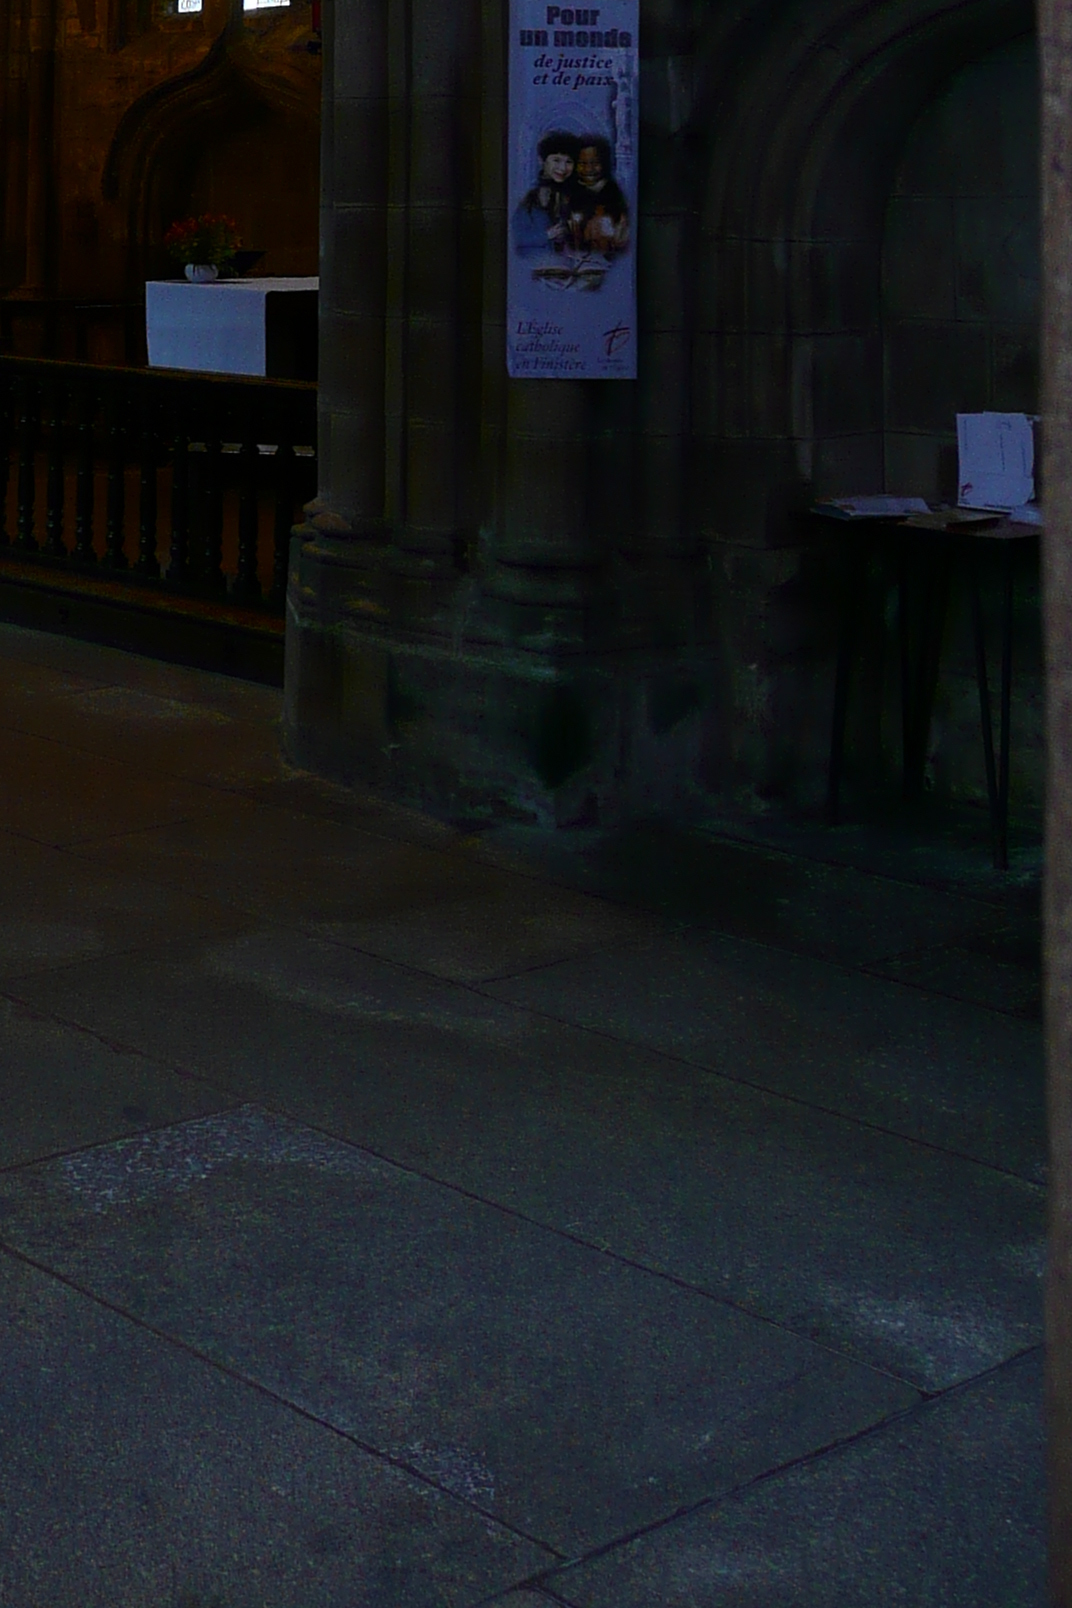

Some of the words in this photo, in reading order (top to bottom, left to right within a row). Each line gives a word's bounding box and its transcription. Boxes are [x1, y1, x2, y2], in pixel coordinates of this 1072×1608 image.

[546, 5, 600, 26] Pour
[519, 29, 549, 47] un
[553, 28, 632, 48] monde
[533, 54, 554, 69] de
[552, 54, 614, 73] justice
[532, 73, 548, 86] et
[552, 71, 571, 86] de
[572, 72, 615, 90] paix
[515, 338, 580, 356] catholique
[515, 359, 530, 371] en
